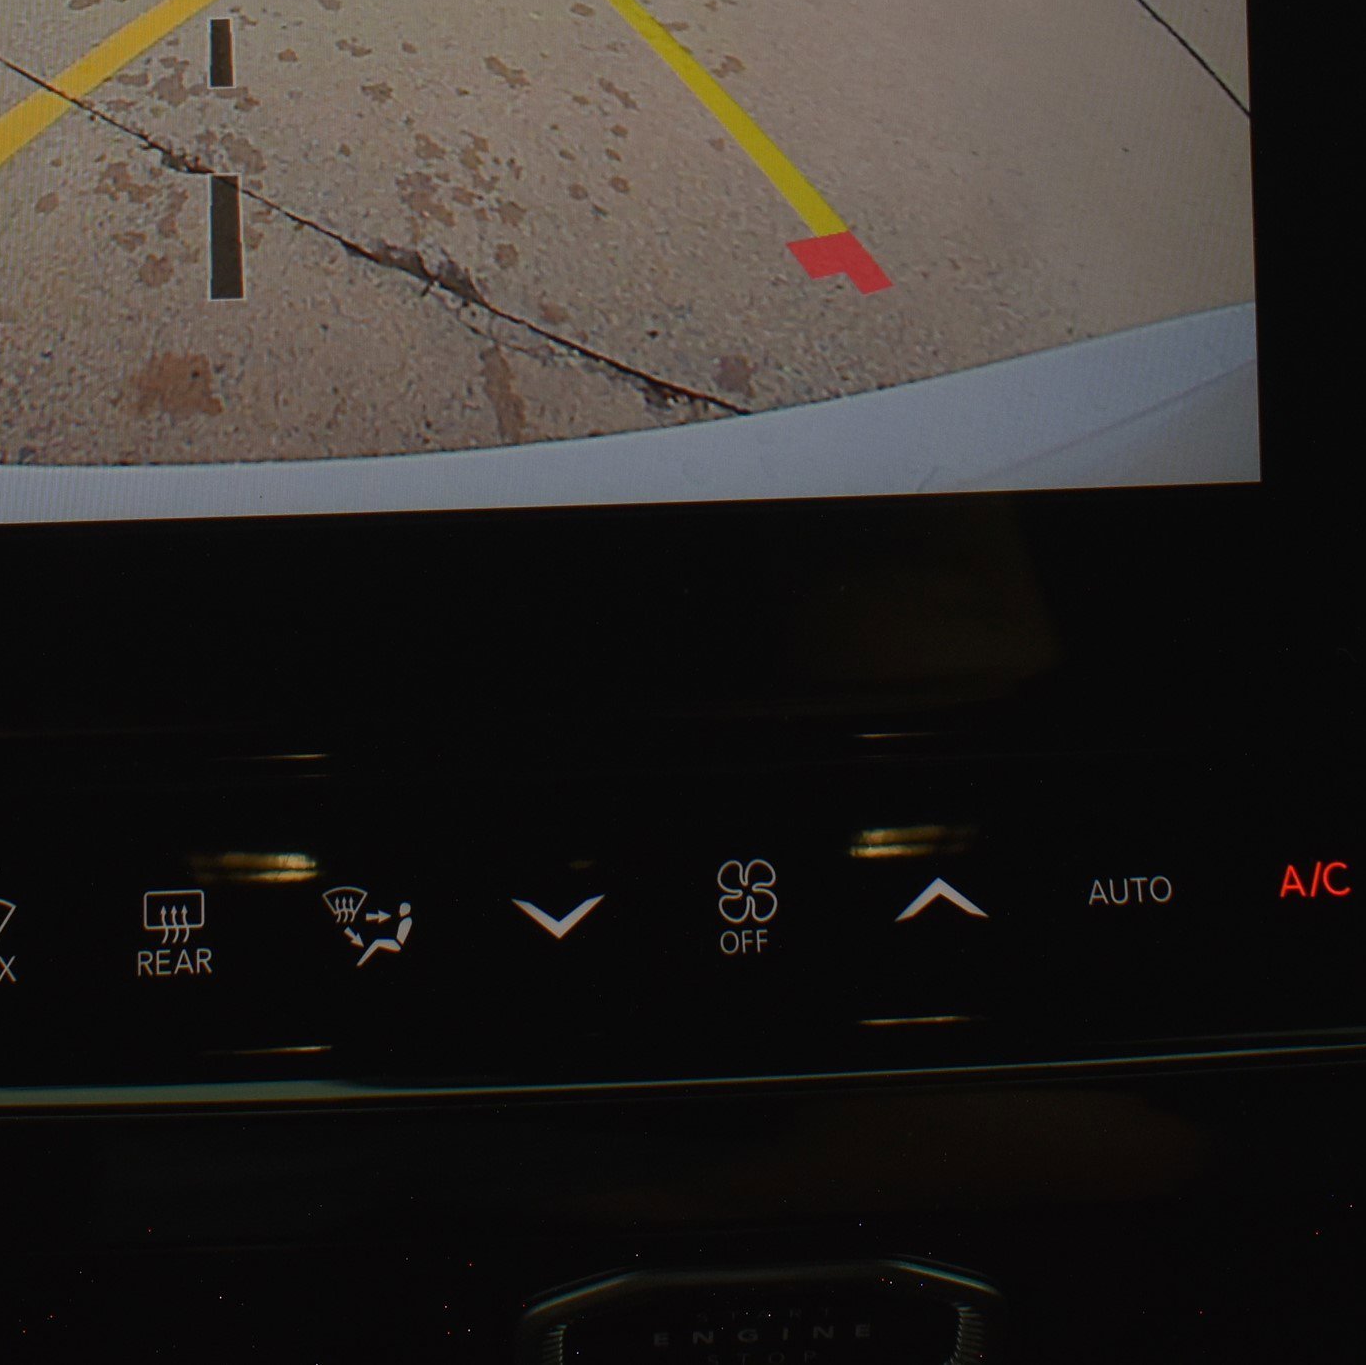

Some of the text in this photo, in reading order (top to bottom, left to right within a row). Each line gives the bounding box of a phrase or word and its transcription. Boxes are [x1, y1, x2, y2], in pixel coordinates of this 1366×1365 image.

[1088, 875, 1174, 906] AUTO
[1280, 861, 1353, 899] A/C
[719, 928, 769, 956] OFF
[137, 948, 213, 978] REAR
[652, 1322, 872, 1347] ENGINE
